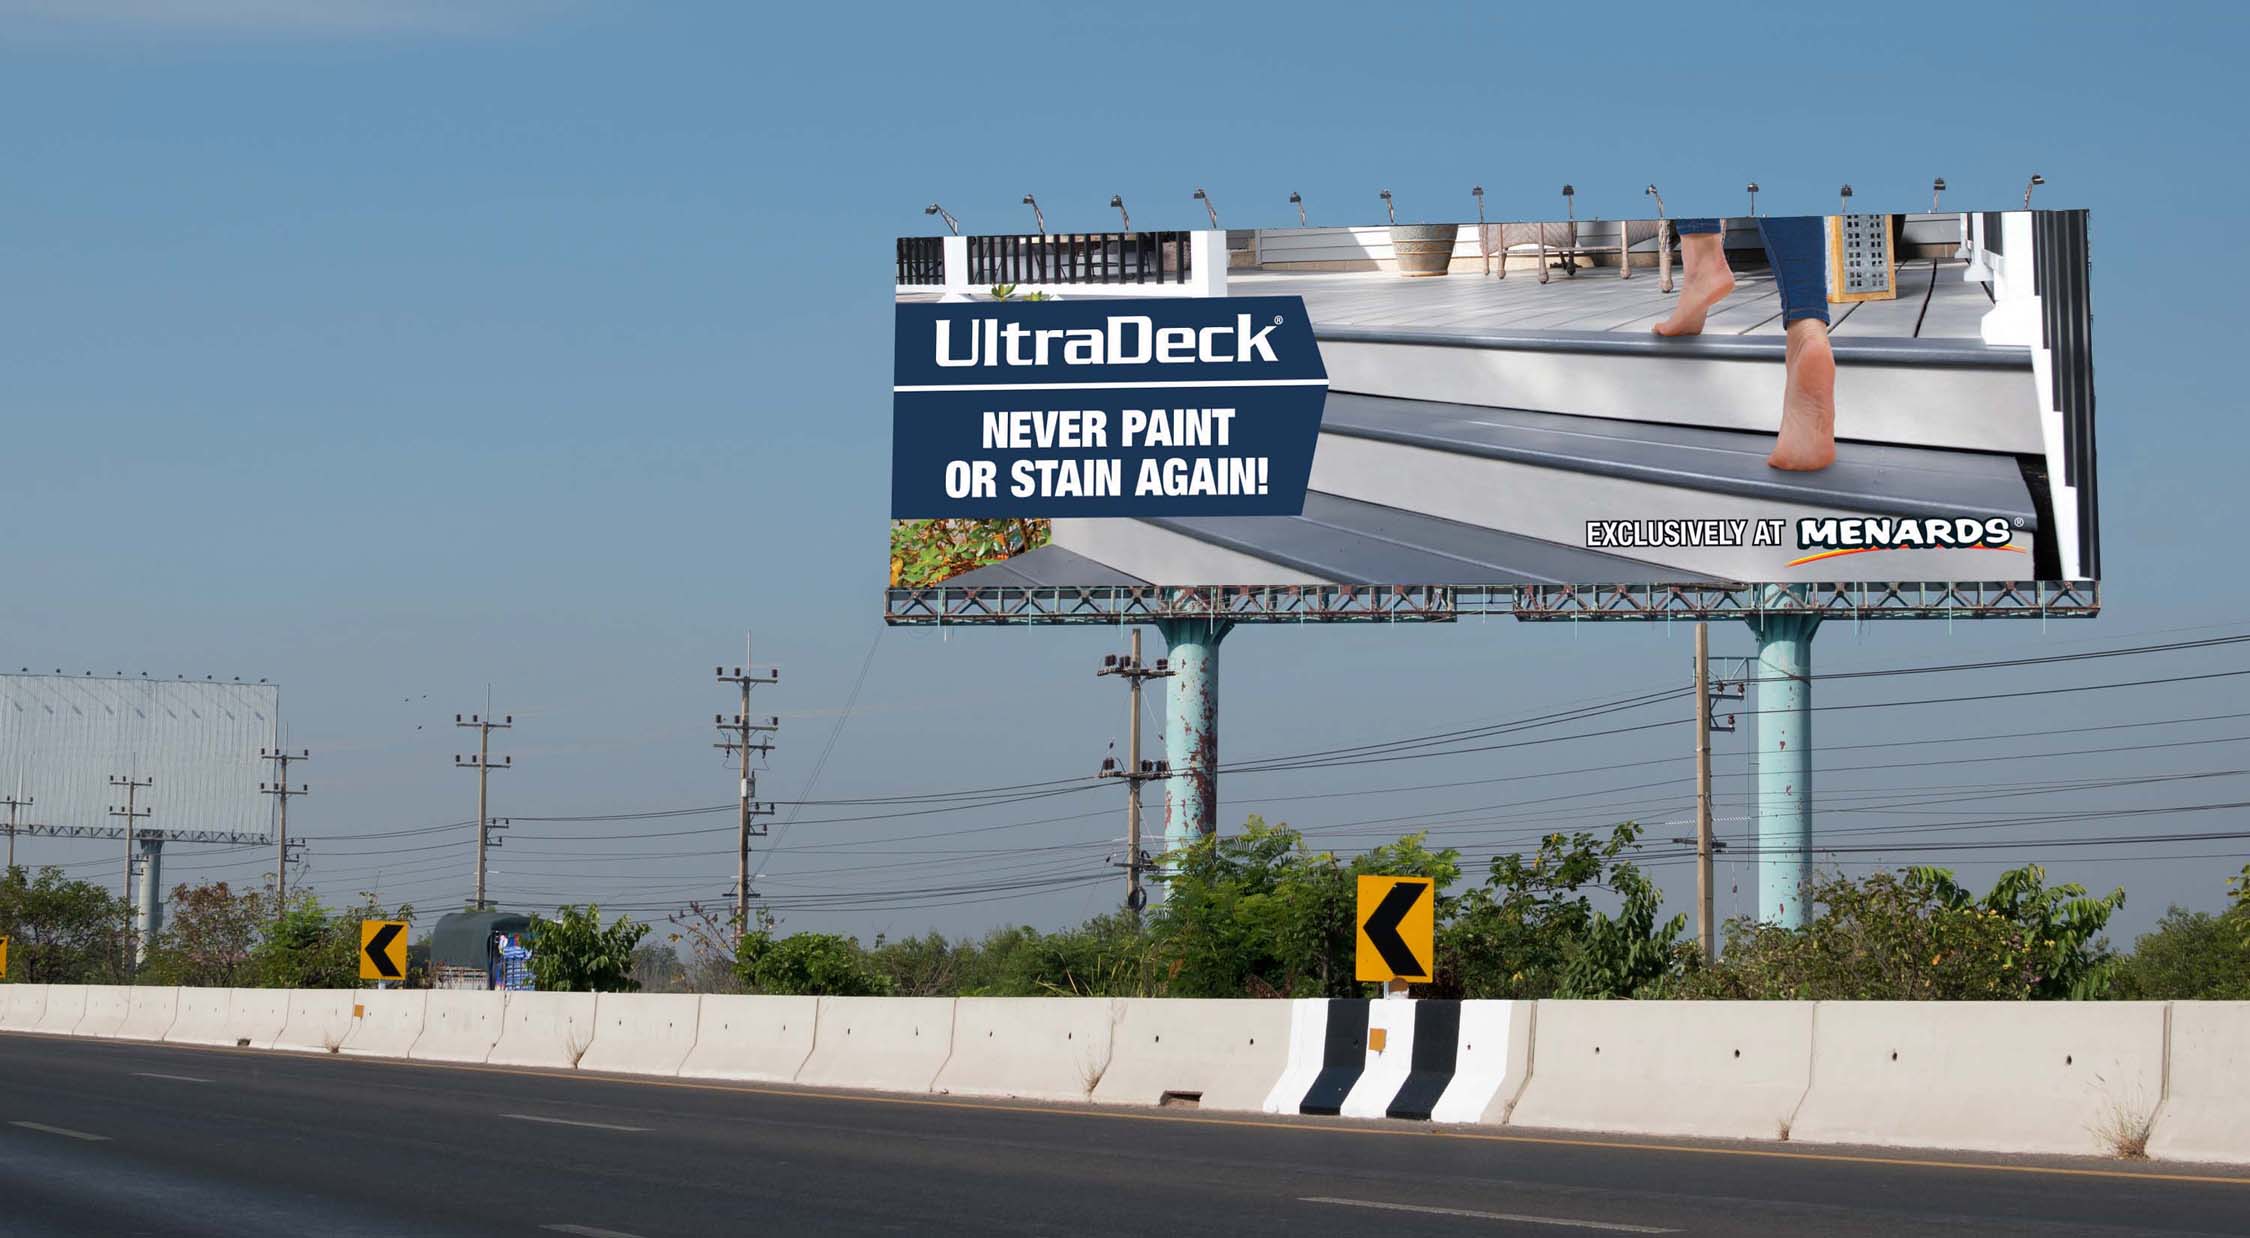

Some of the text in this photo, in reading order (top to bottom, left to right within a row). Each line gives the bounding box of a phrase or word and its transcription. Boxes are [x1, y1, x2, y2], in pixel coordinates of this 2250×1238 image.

[982, 407, 1236, 449] NEVER PAINT
[945, 456, 1269, 499] OR STAIN AGAIN!
[1585, 519, 1749, 548] EXCLUSIVELY
[1752, 519, 1786, 547] AT
